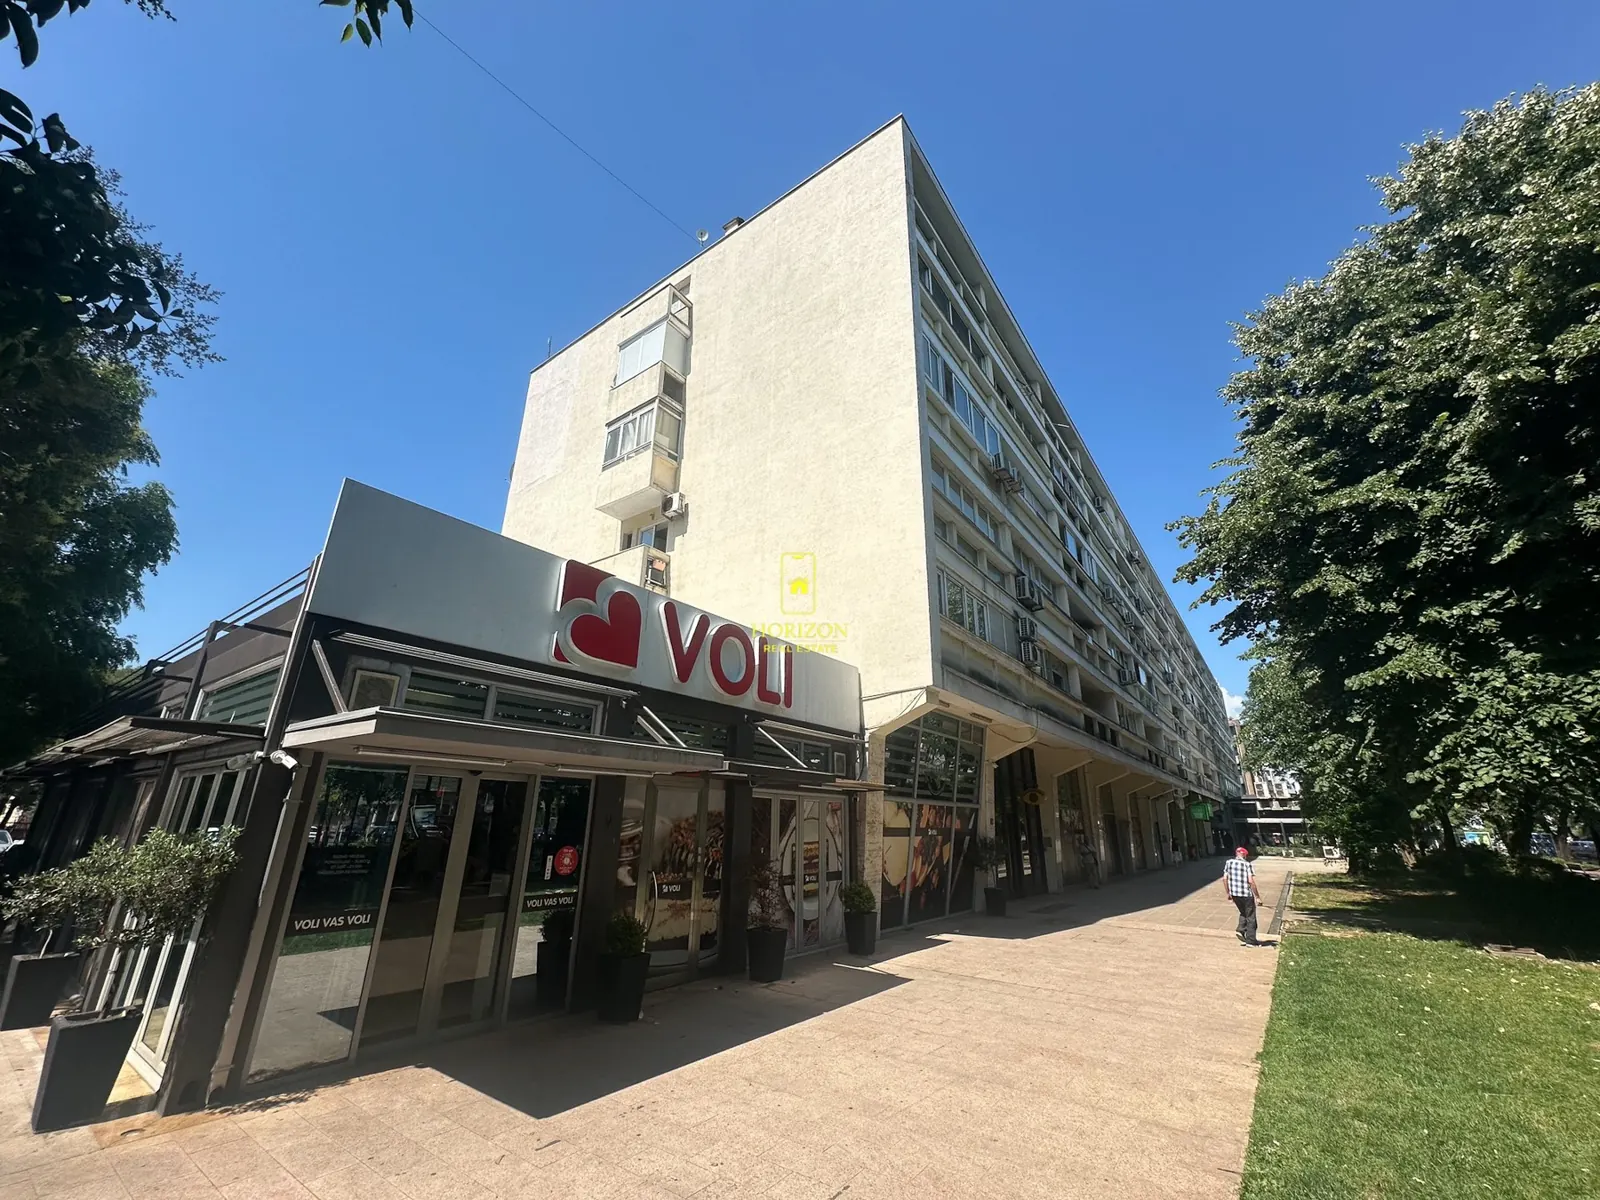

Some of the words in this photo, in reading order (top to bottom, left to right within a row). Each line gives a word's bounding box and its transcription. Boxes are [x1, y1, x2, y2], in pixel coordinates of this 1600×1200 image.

[659, 601, 792, 709] VOLI
[526, 899, 543, 908] VOLI
[543, 898, 558, 906] VAS
[558, 896, 574, 905] VOLI
[294, 919, 320, 931] VOLI
[323, 917, 345, 928] VAS
[347, 914, 371, 925] VOLI
